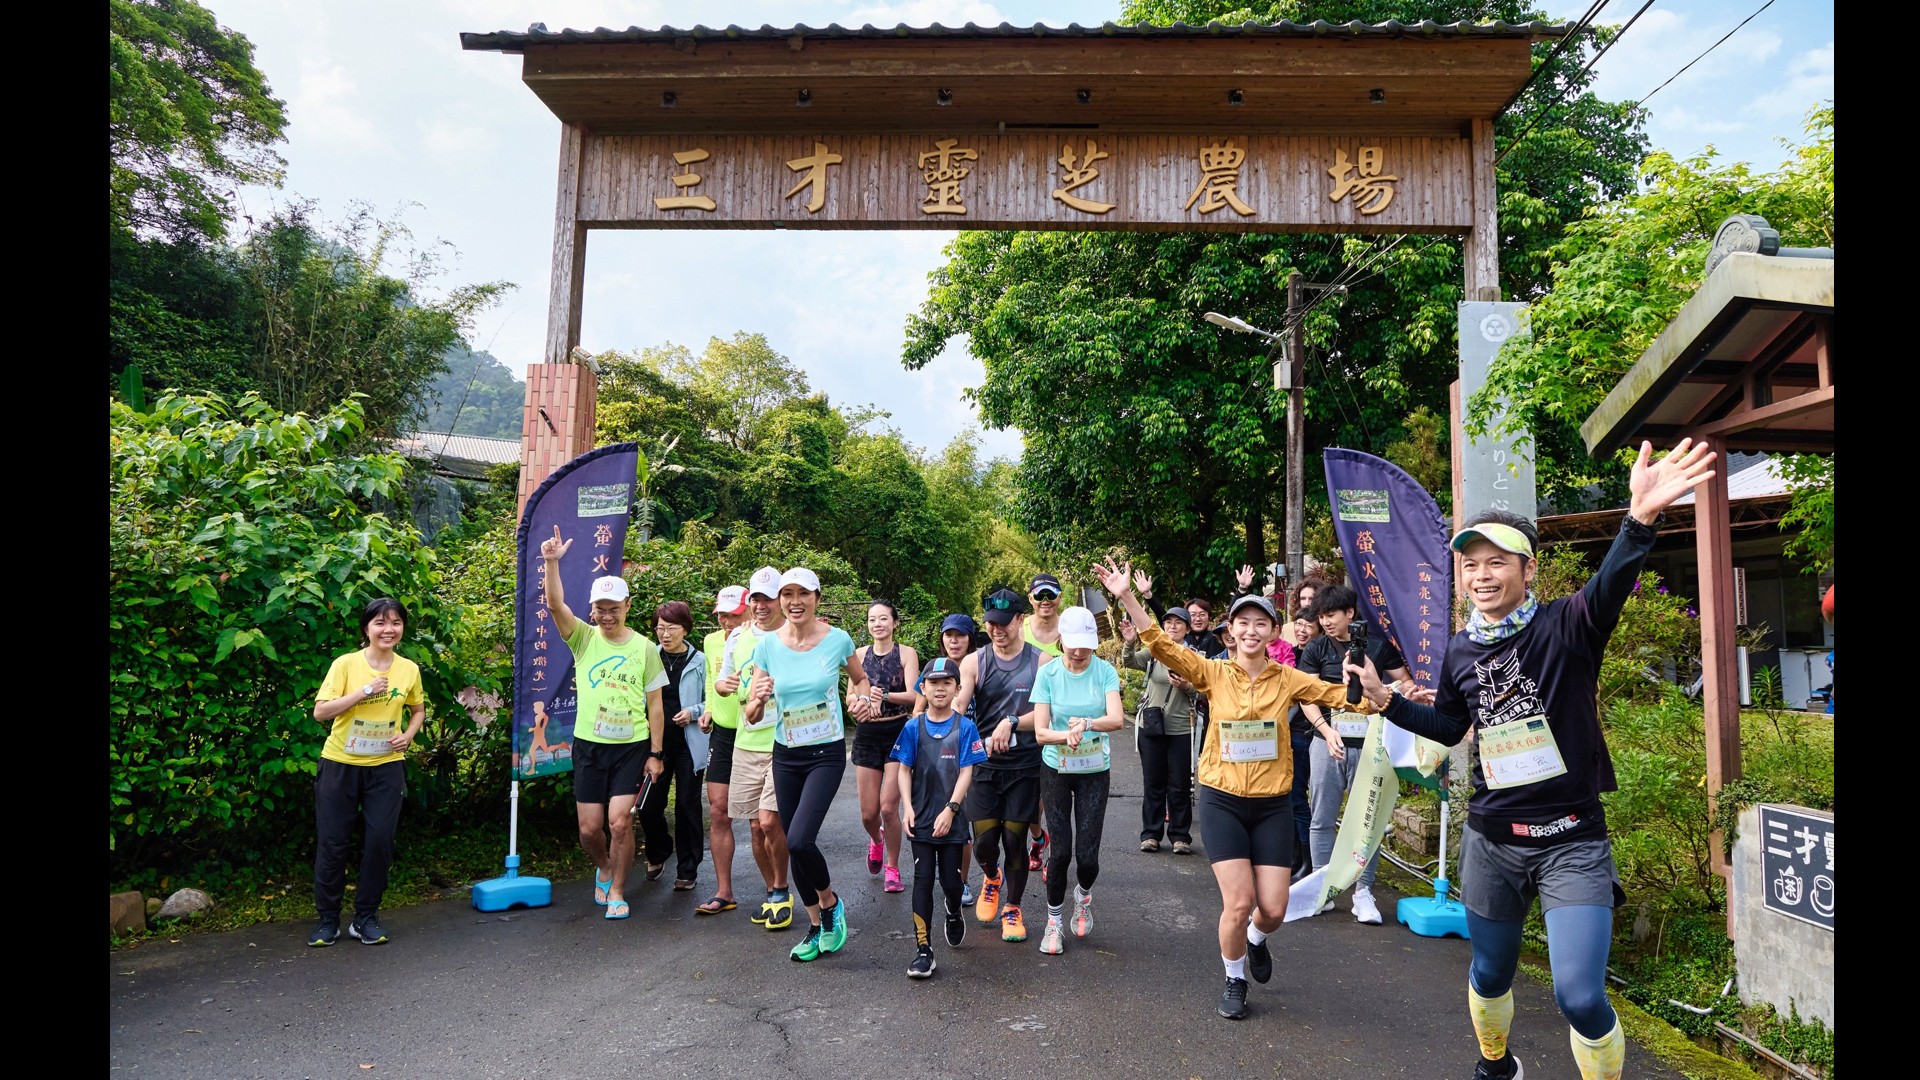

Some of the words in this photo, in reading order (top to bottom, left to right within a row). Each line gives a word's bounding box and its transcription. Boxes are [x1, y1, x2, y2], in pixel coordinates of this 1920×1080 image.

[654, 137, 1399, 216] 三才靈芝農場
[1232, 744, 1258, 754] Lucy
[1785, 878, 1797, 898] 茶
